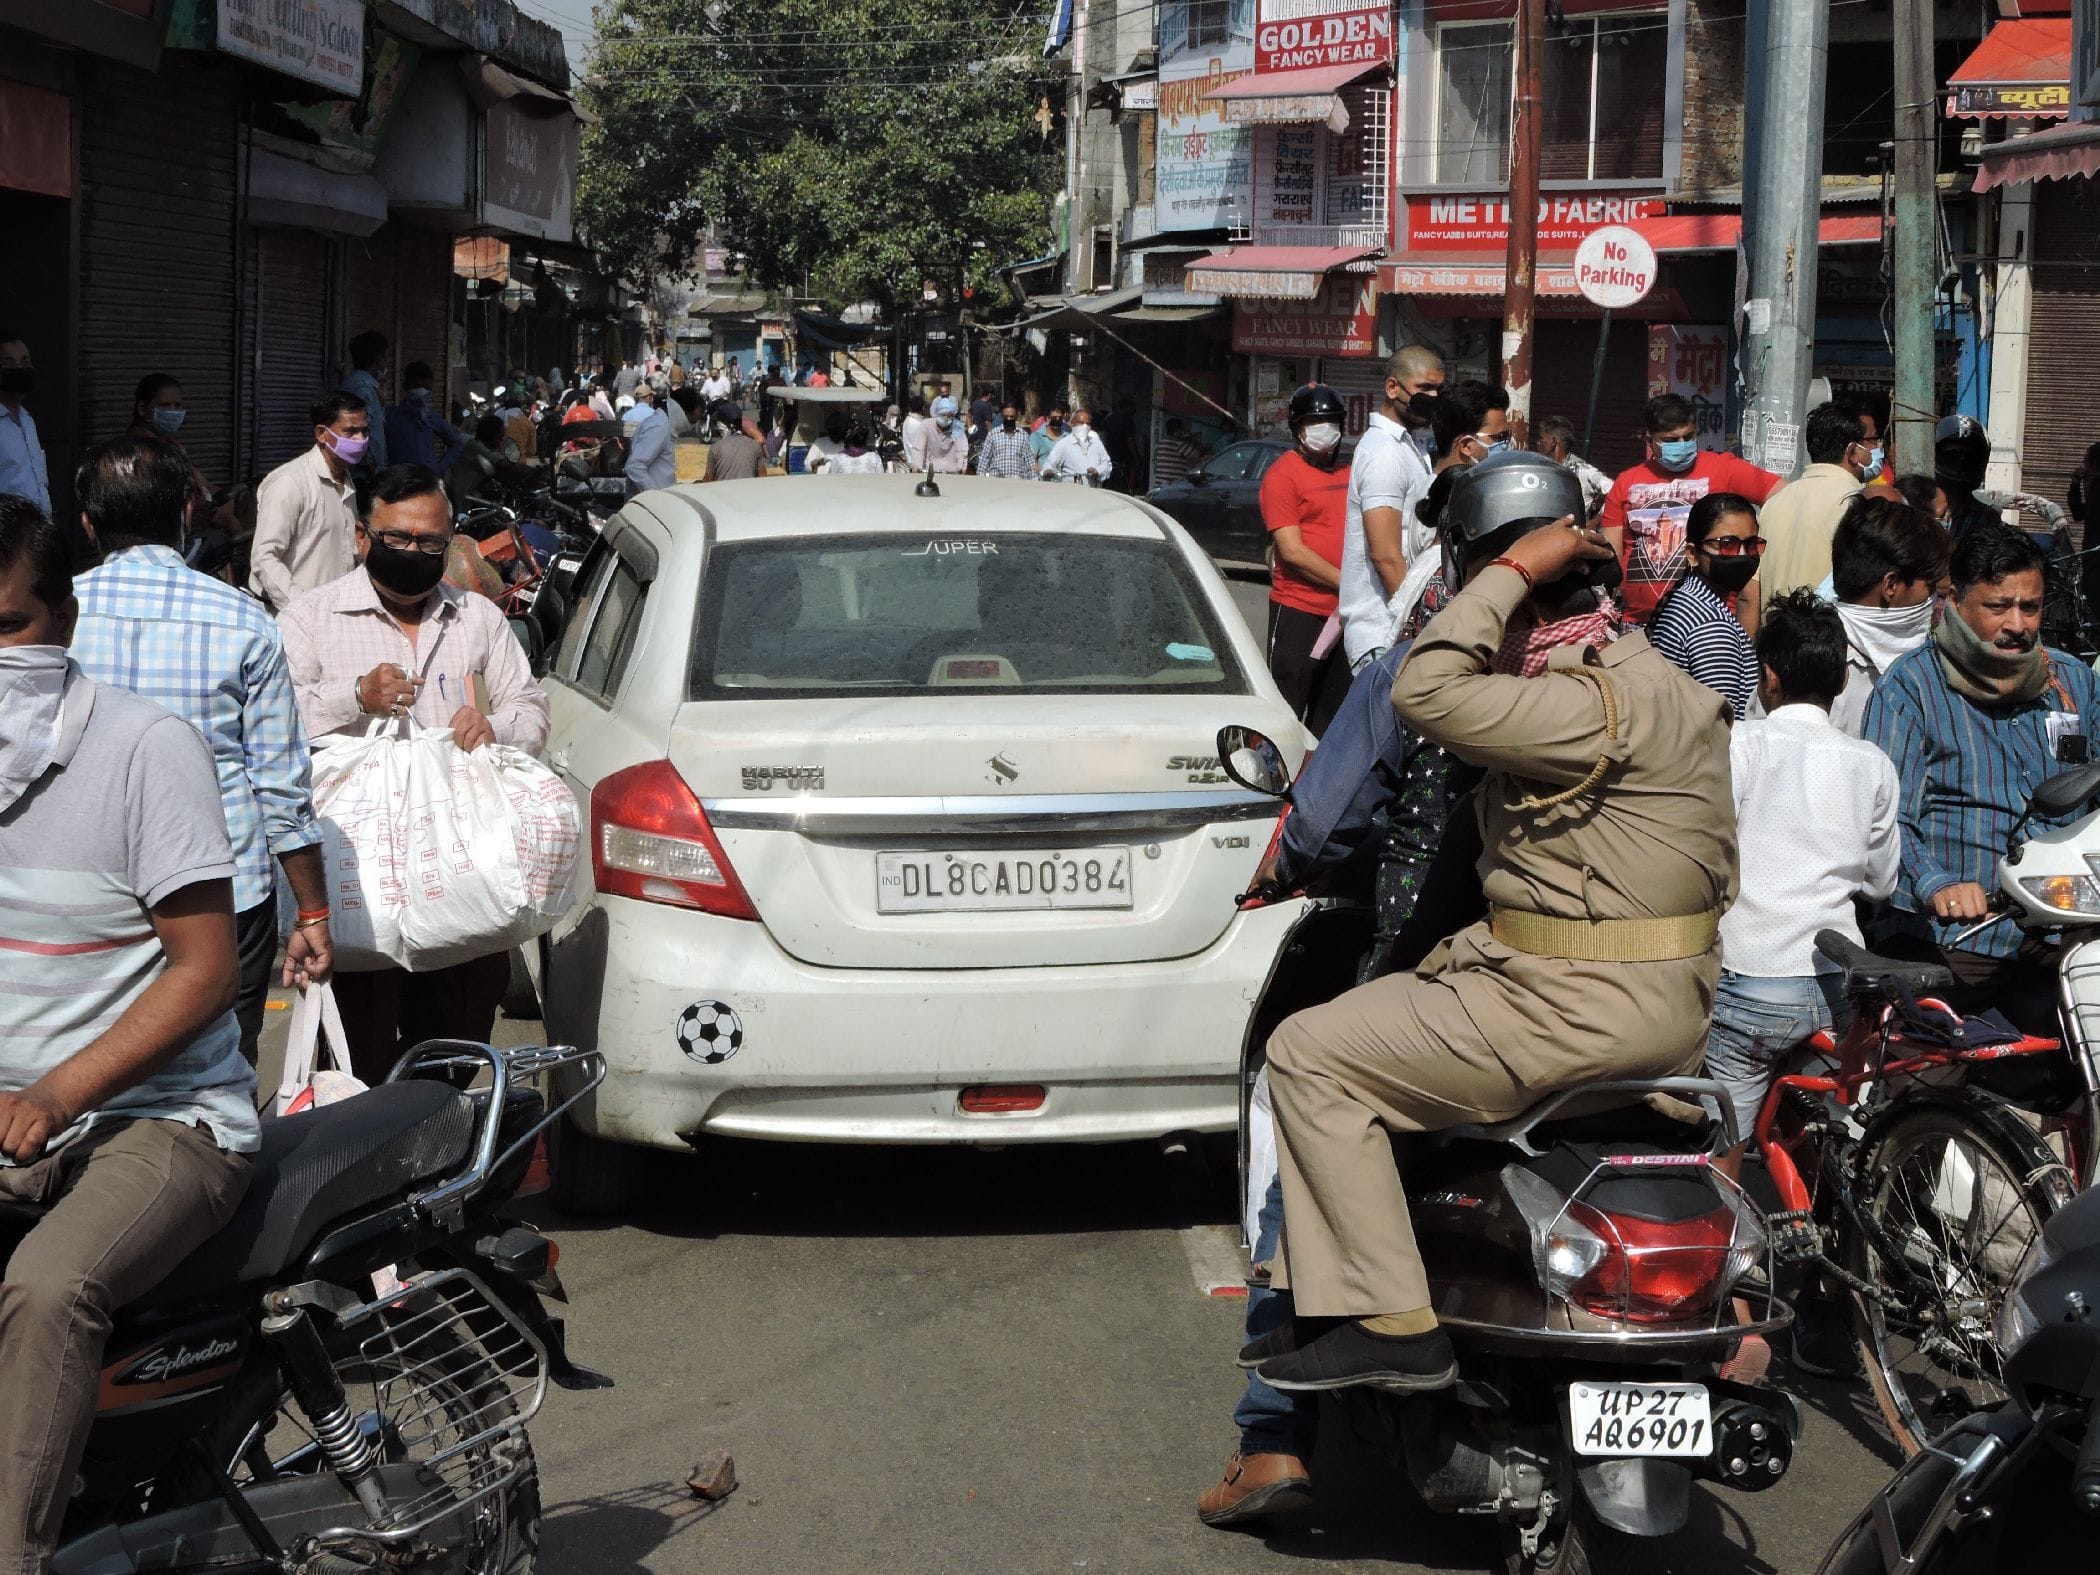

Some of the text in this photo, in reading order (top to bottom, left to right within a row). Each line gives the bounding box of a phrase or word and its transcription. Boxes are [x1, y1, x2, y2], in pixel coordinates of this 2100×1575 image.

[1260, 12, 1390, 52] GOLDEN
[1270, 42, 1376, 69] FANCY WEAR
[1554, 197, 1648, 224] FABRIC
[1604, 241, 1627, 261] No
[1580, 264, 1646, 293] Parking
[1252, 319, 1358, 336] FANCY WEAR
[741, 765, 824, 778] MARUTI
[1166, 755, 1224, 770] SWIF
[1188, 772, 1230, 784] DZIR
[1211, 836, 1249, 848] VDI
[881, 858, 1125, 898] IND DL8CAD0384
[1631, 1155, 1700, 1165] DESTINI
[1584, 1416, 1705, 1453] AQ6901
